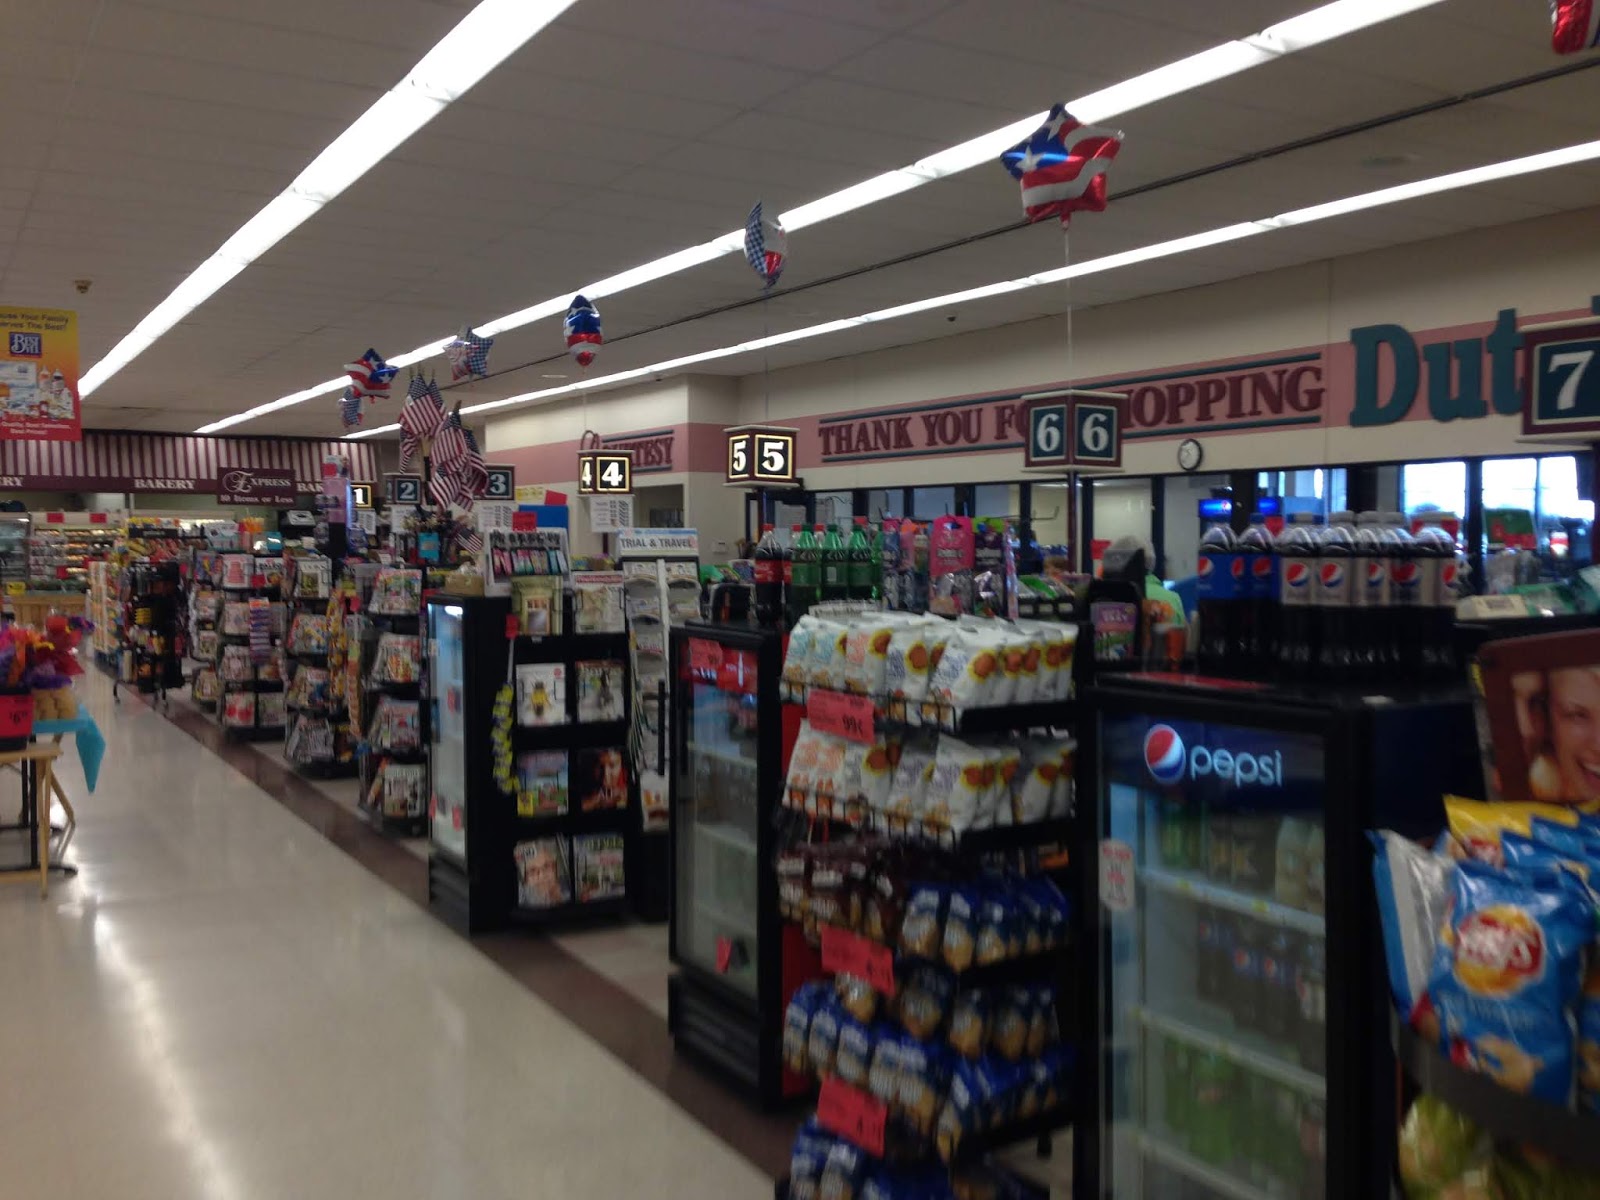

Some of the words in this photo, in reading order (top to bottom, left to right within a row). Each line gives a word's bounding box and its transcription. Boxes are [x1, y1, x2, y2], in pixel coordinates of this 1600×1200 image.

[1349, 308, 1525, 428] Dut
[1549, 350, 1594, 410] 7
[818, 417, 912, 456] THANK
[921, 407, 983, 446] YOU
[1120, 366, 1325, 430] OPPING
[1037, 413, 1060, 452] 6
[1082, 413, 1109, 452] 6
[733, 440, 747, 472] 5
[761, 441, 785, 472] 5
[134, 478, 196, 490] BAKERY
[296, 482, 324, 492] BAK
[489, 473, 508, 495] 3
[581, 461, 592, 486] 4
[601, 461, 624, 487] 4
[400, 481, 416, 500] 2
[620, 537, 647, 549] TRIAL
[649, 538, 657, 548] &
[656, 537, 693, 549] TRAVEL
[1190, 745, 1282, 788] pepsi
